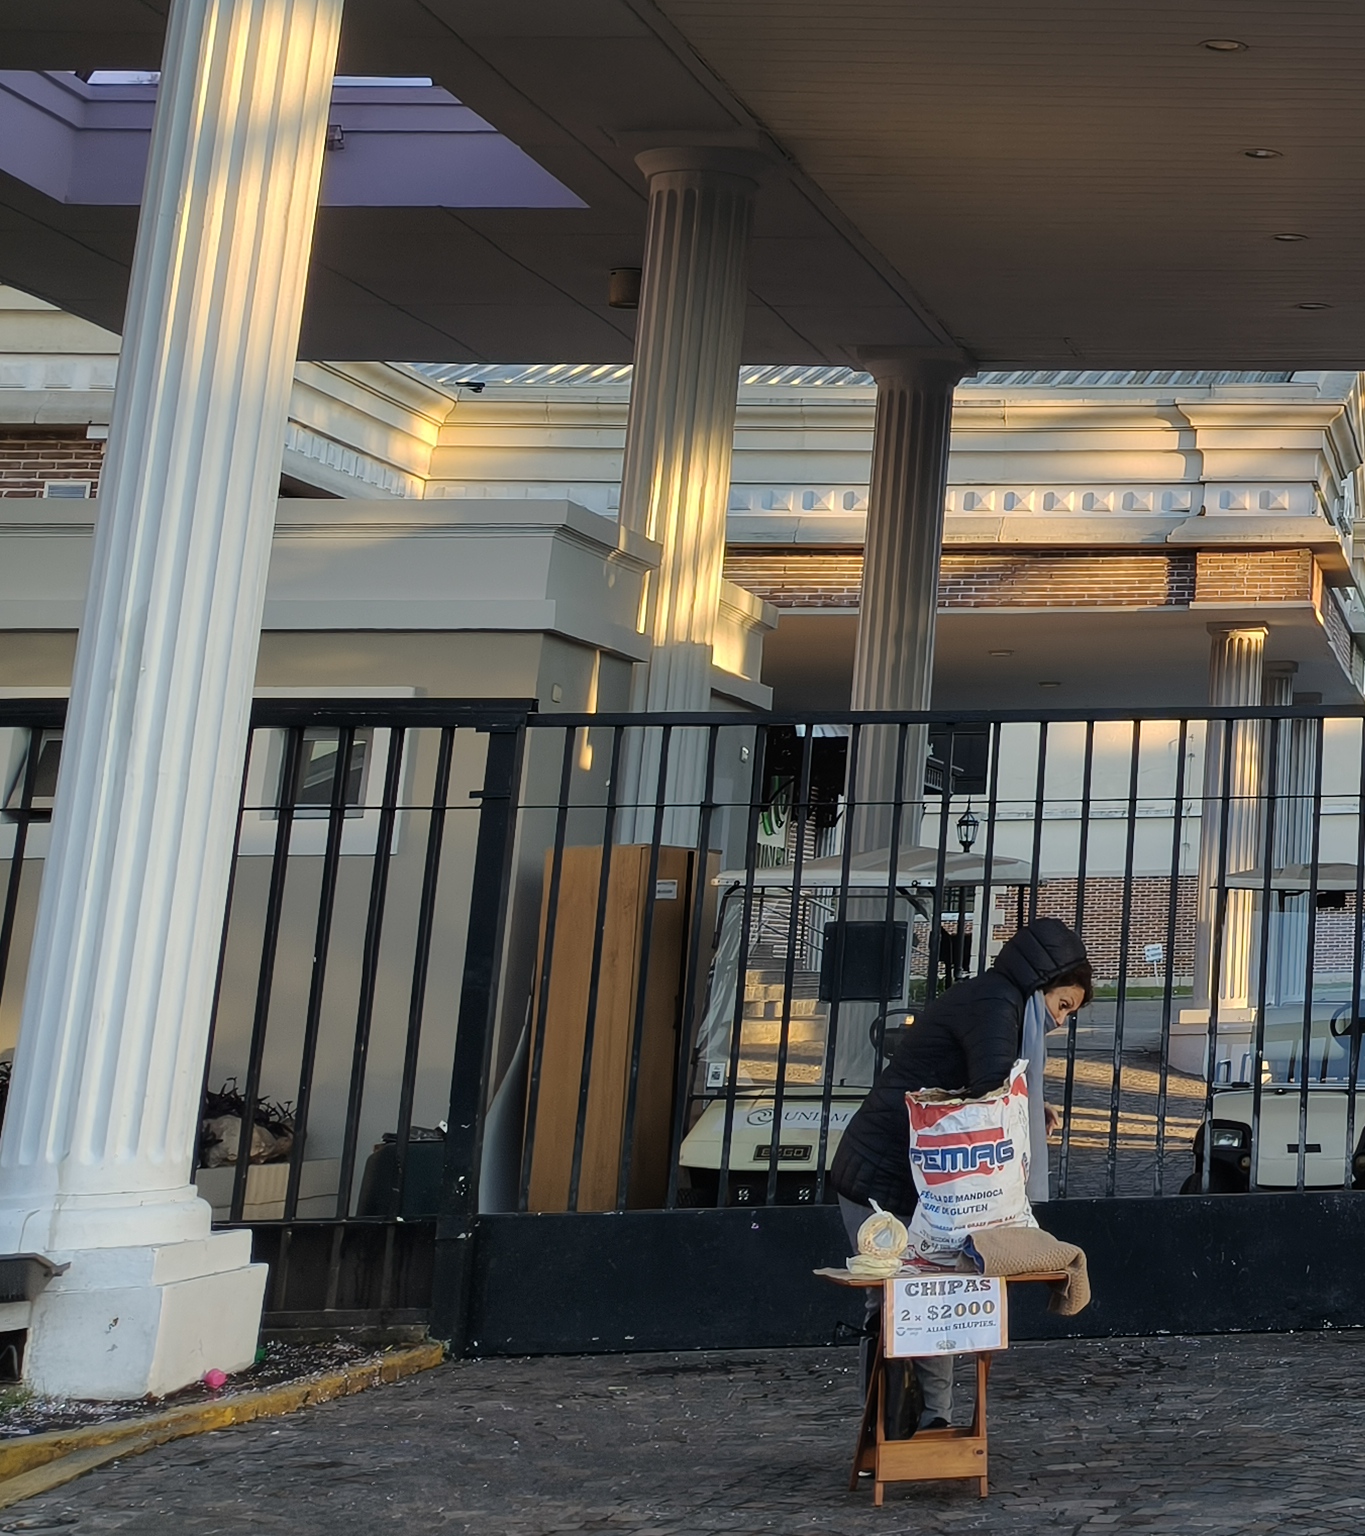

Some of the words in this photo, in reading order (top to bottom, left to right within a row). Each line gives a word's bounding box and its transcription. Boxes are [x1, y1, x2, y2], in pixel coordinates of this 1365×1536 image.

[784, 1111, 849, 1123] UNLM
[955, 1188, 1003, 1203] MANDIOCA
[950, 1203, 988, 1216] GLUTEN
[905, 1279, 991, 1297] CHIPAS
[901, 1310, 910, 1321] 2
[927, 1300, 995, 1321] $2000
